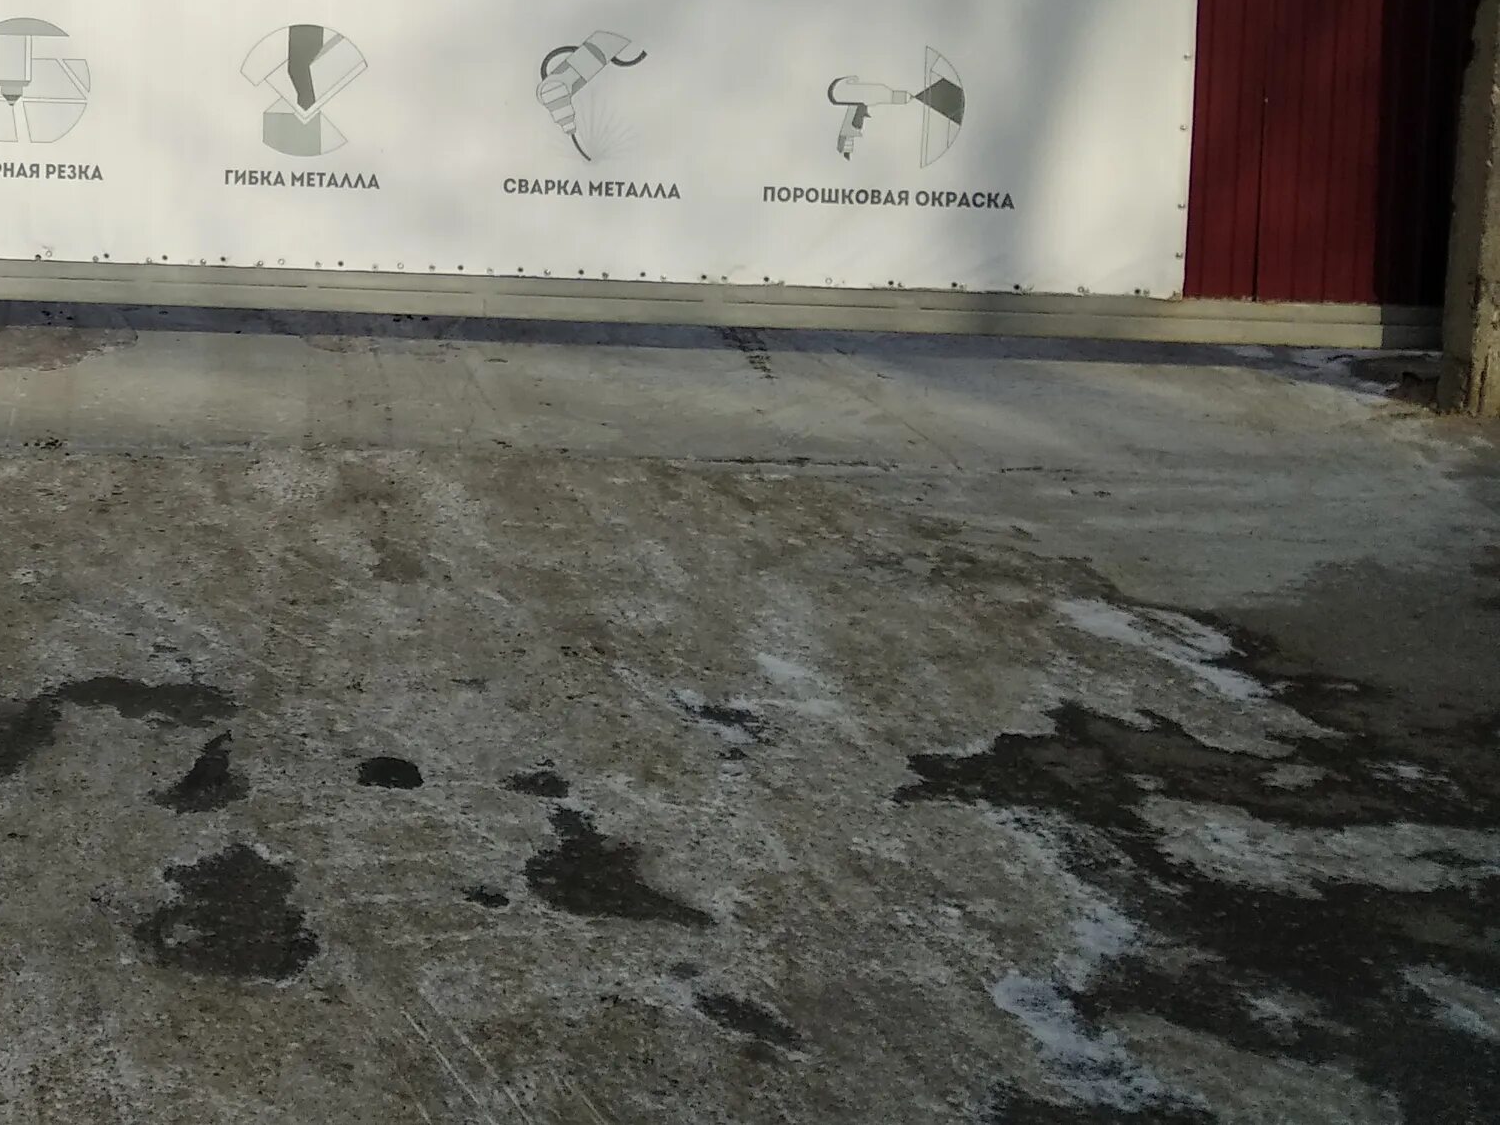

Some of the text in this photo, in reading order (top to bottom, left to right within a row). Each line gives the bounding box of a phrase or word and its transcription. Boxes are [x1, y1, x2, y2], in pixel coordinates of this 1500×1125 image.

[45, 163, 104, 181] РЕЗКА
[224, 169, 381, 190] ГИБКА МЕТАЛЛА
[503, 177, 681, 200] СВАРКА МЕТАЛЛА
[763, 186, 1015, 210] ПОРОШКОВАЯ ОКРАСКА
